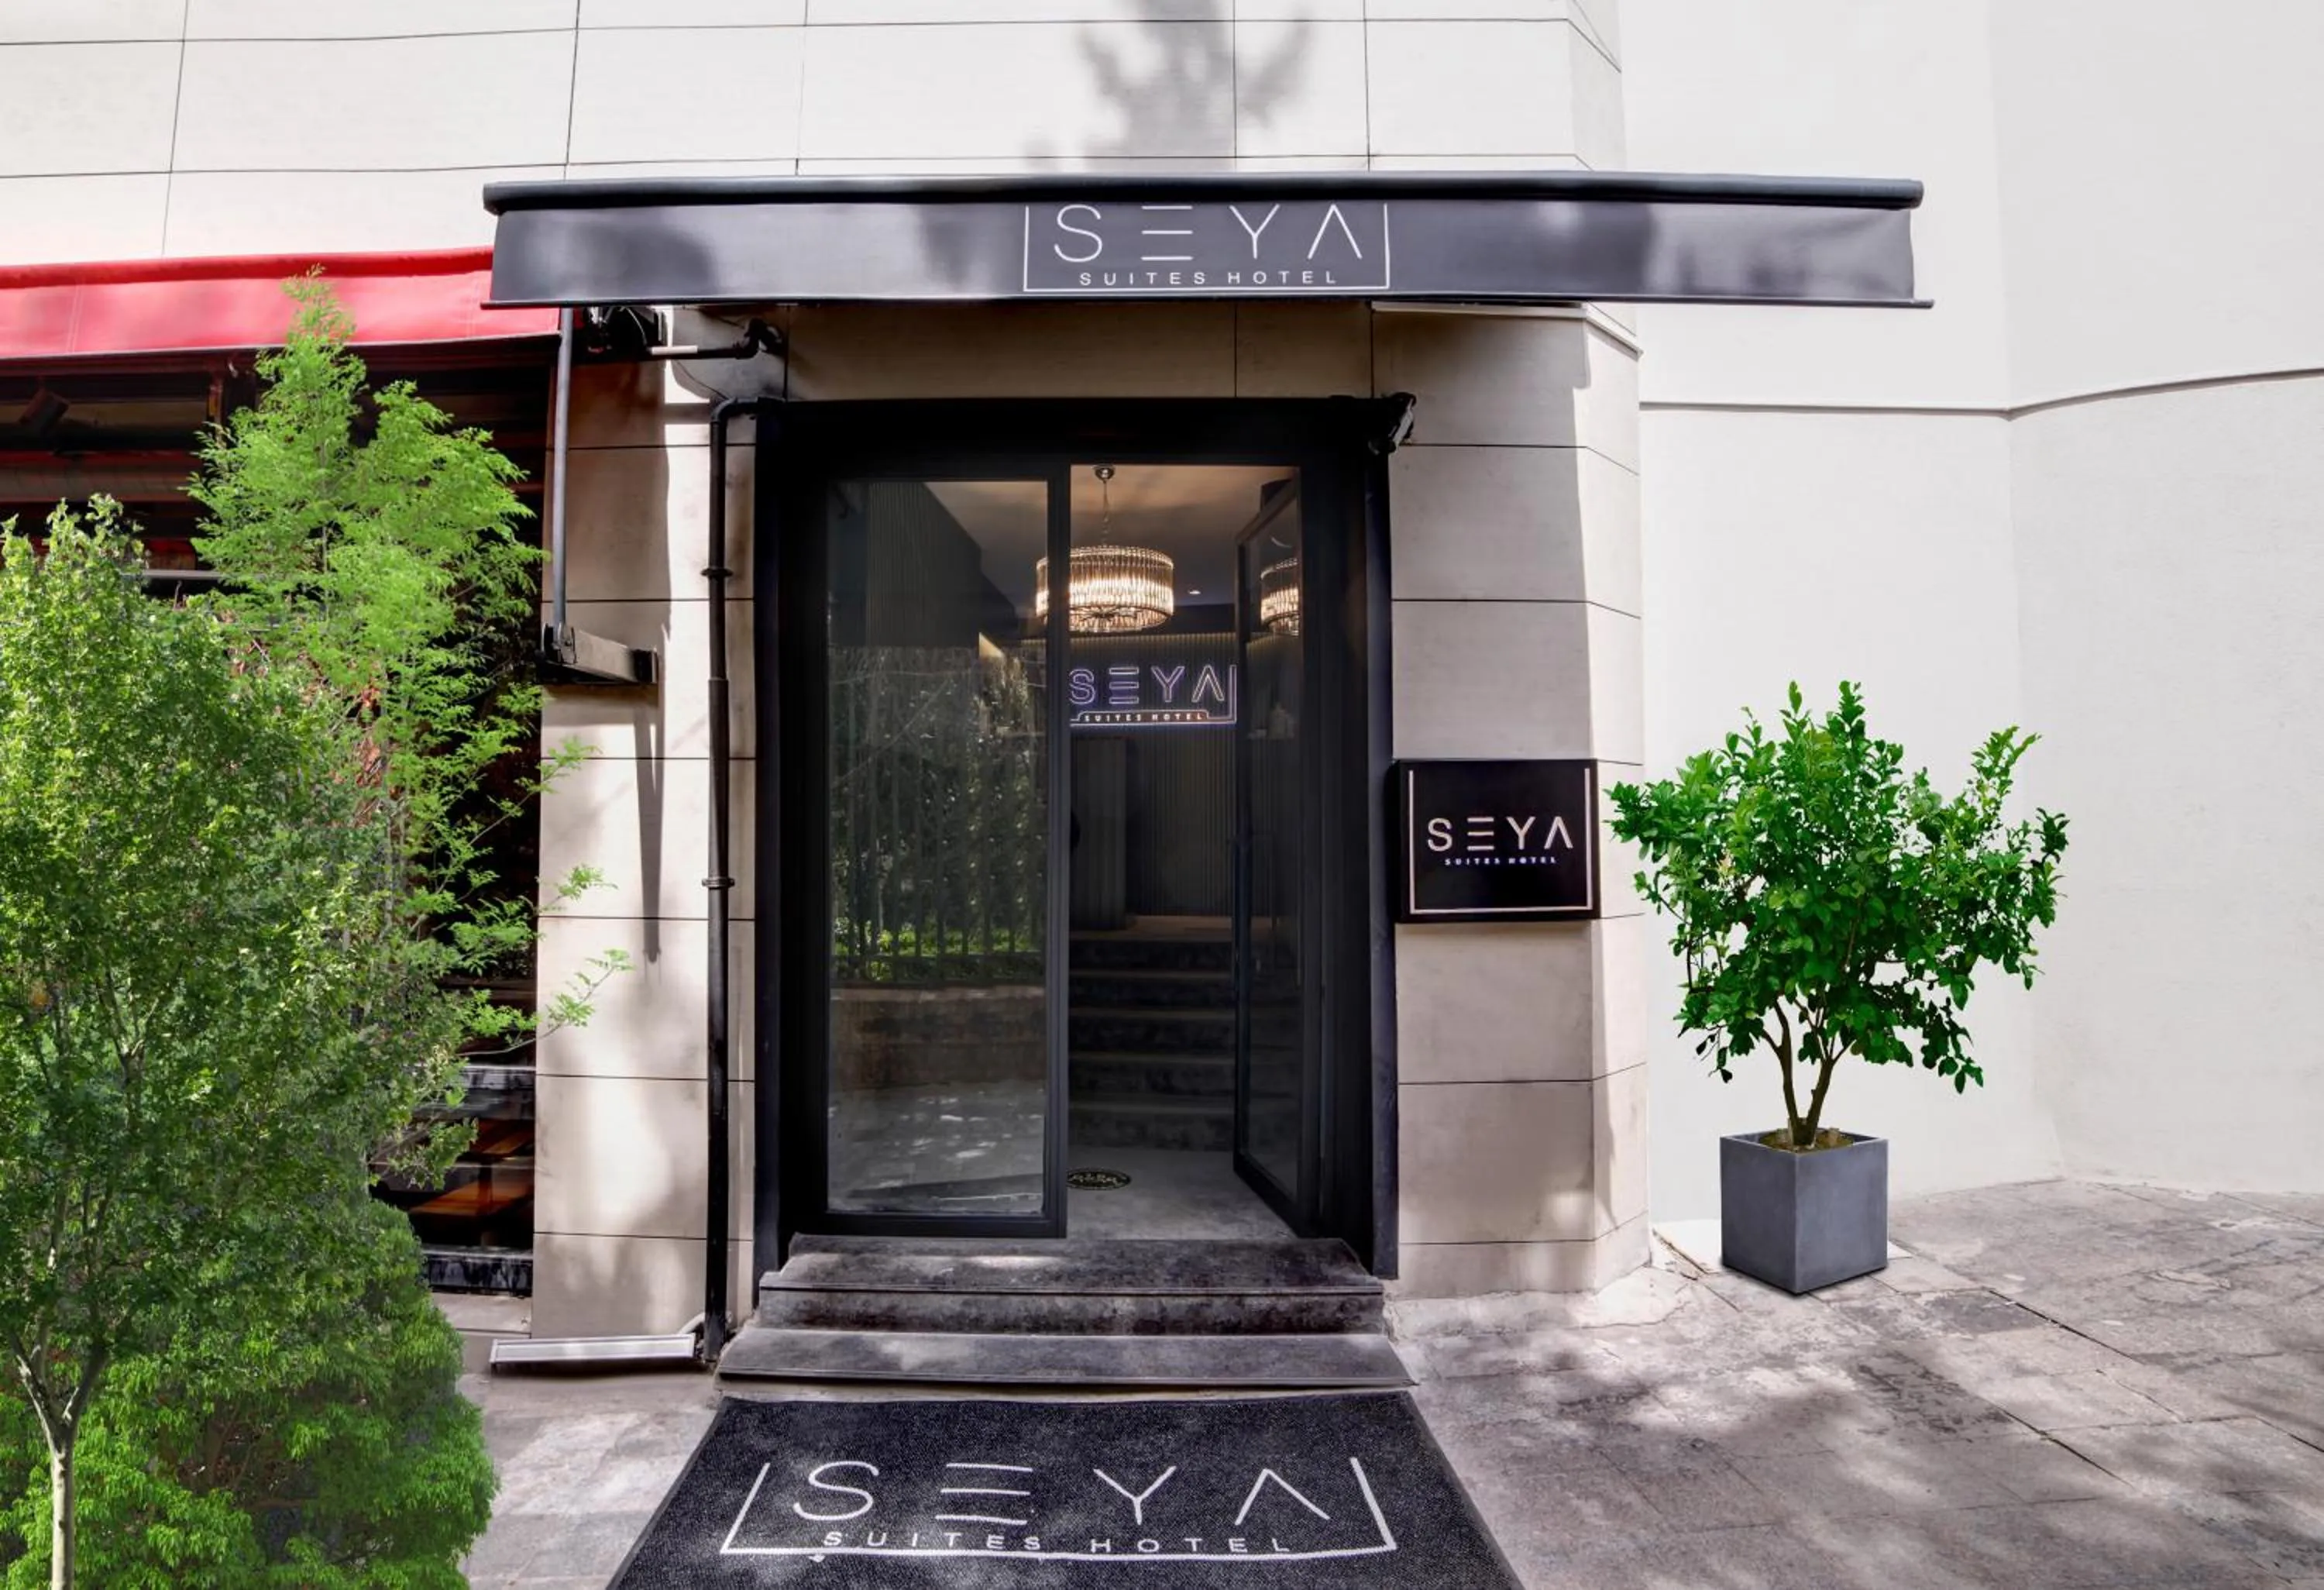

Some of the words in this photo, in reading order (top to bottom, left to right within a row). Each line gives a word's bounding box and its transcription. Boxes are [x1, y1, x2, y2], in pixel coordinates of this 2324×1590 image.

[1054, 204, 1363, 263] SEYA
[1079, 272, 1205, 286] SUITES
[1228, 270, 1336, 284] HOTEL
[1069, 664, 1225, 705] SEYA
[1085, 714, 1142, 722] SUITES
[1151, 712, 1204, 721] HOTEL
[1427, 816, 1574, 852] SEYA
[793, 1460, 1331, 1526] SEYA
[823, 1530, 1042, 1550] SUITES
[1091, 1537, 1291, 1554] HOTEL
